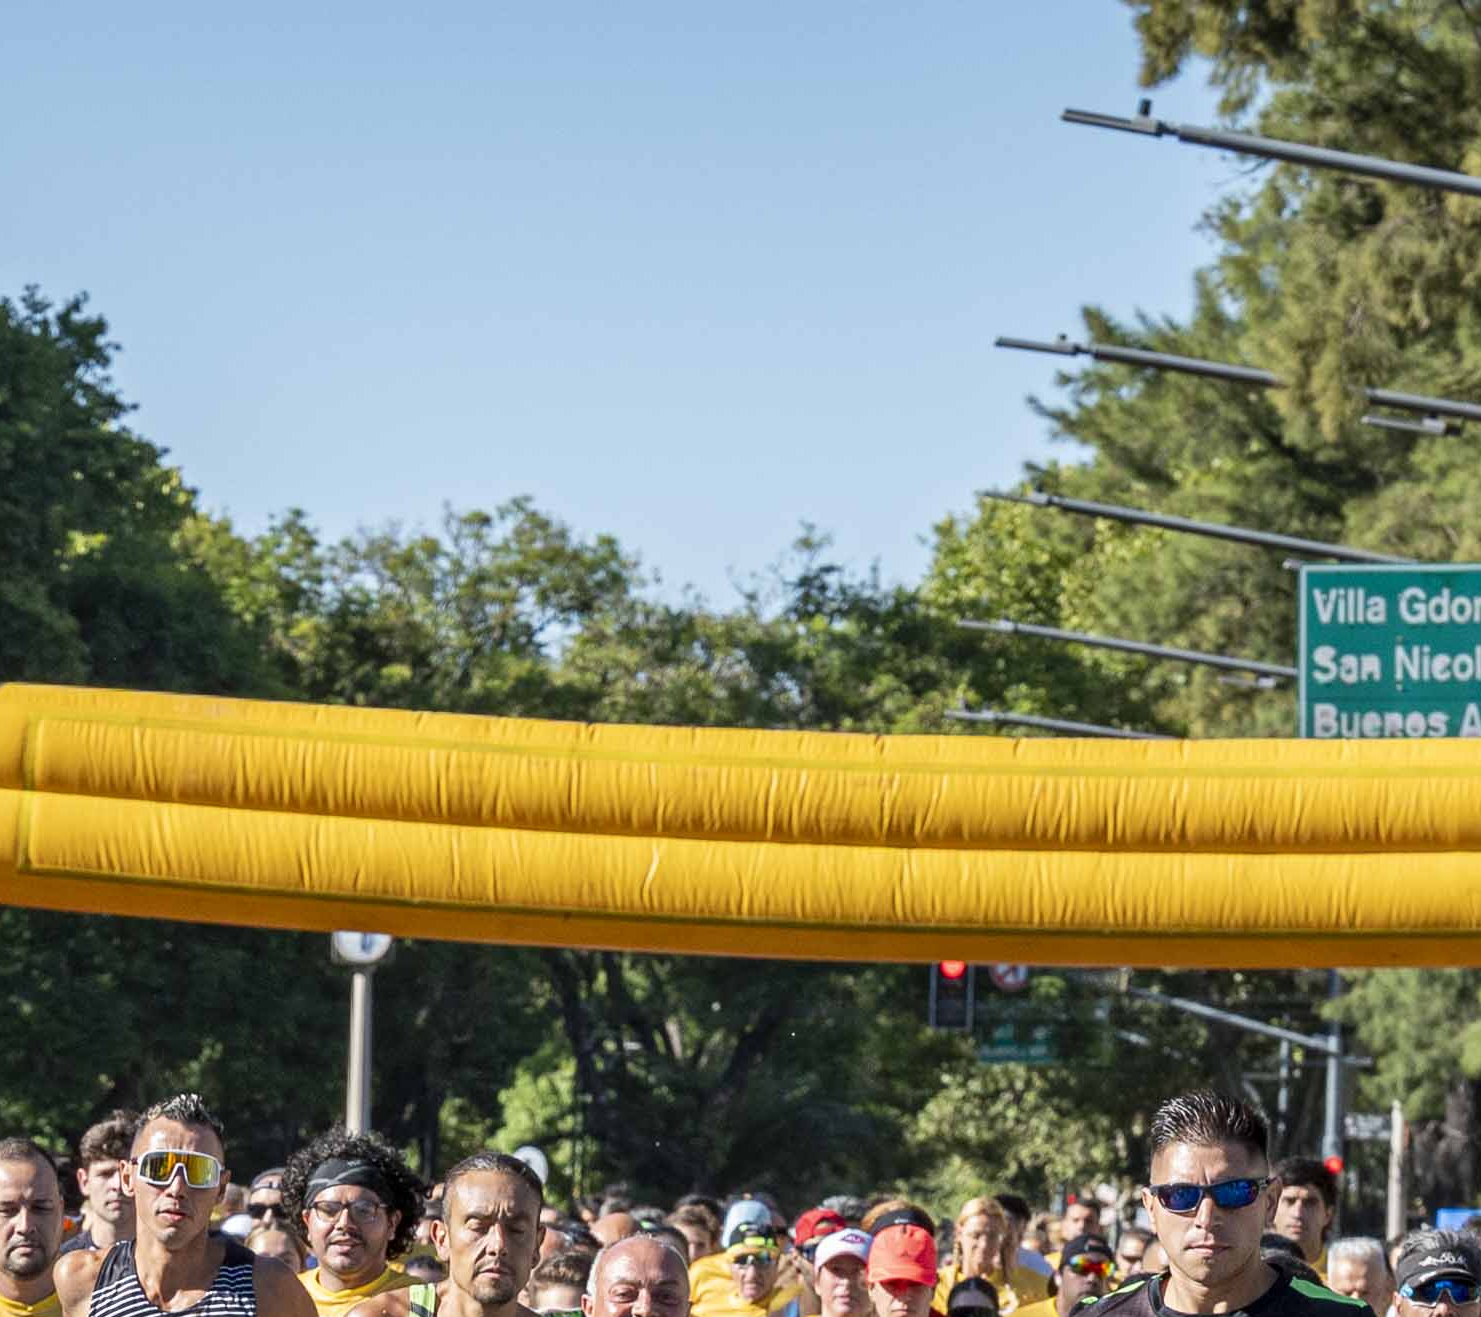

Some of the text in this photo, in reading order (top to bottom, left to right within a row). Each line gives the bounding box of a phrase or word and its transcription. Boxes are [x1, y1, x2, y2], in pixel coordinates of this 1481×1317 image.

[1313, 588, 1386, 624] Villa
[1312, 645, 1382, 683] San
[1313, 703, 1449, 738] Buenos
